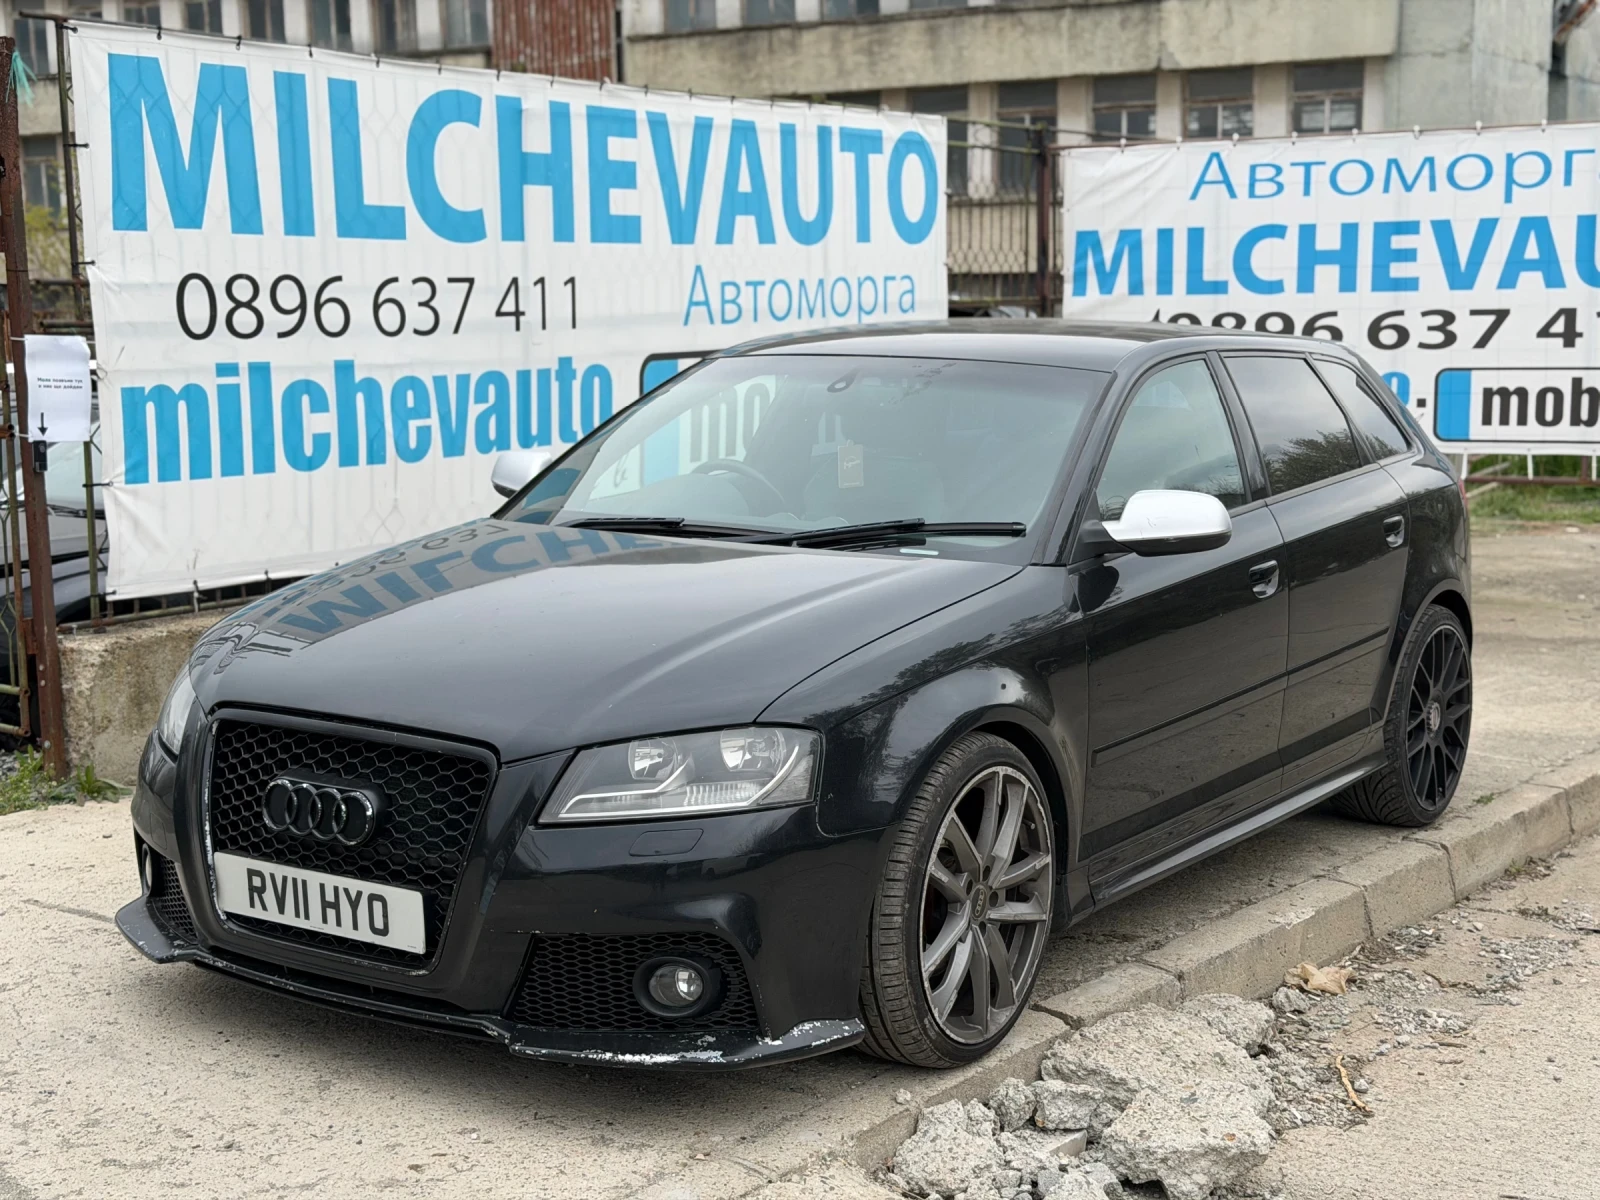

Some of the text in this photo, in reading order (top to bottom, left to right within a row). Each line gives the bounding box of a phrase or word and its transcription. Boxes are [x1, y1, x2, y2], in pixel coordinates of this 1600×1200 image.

[108, 53, 939, 247] MILCHEVAUTO
[1190, 149, 1600, 204] Автоморг
[176, 273, 577, 340] 0896 637 411
[683, 265, 915, 325] Автоморга
[1367, 309, 1511, 350] 637
[1536, 307, 1600, 348] 4
[121, 357, 613, 486] milchevauto
[246, 868, 390, 937] RV11 HYO
